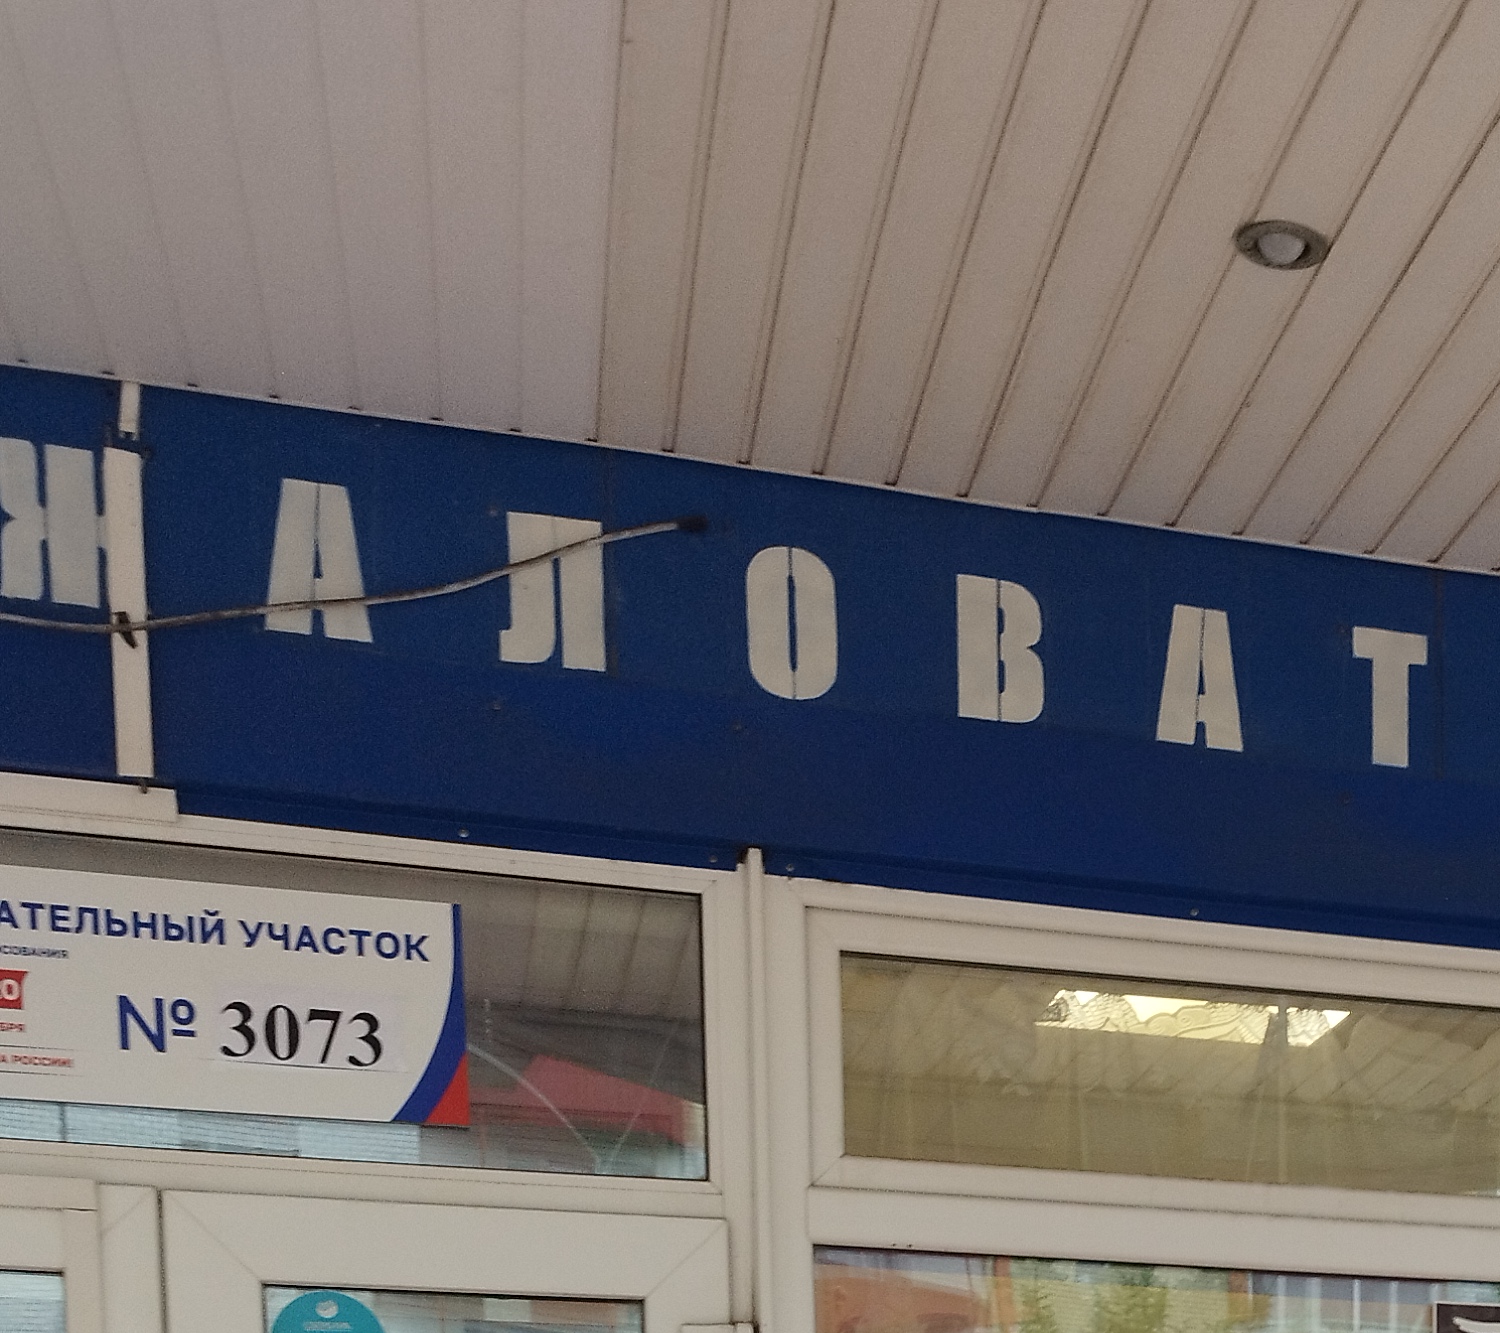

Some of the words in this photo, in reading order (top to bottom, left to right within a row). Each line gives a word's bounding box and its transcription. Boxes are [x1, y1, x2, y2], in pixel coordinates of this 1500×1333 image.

[0, 899, 226, 945] АТЕЛЬНЫЙ
[239, 919, 430, 962] УЧАСТОК
[117, 994, 197, 1053] №
[220, 1000, 383, 1067] 3073
